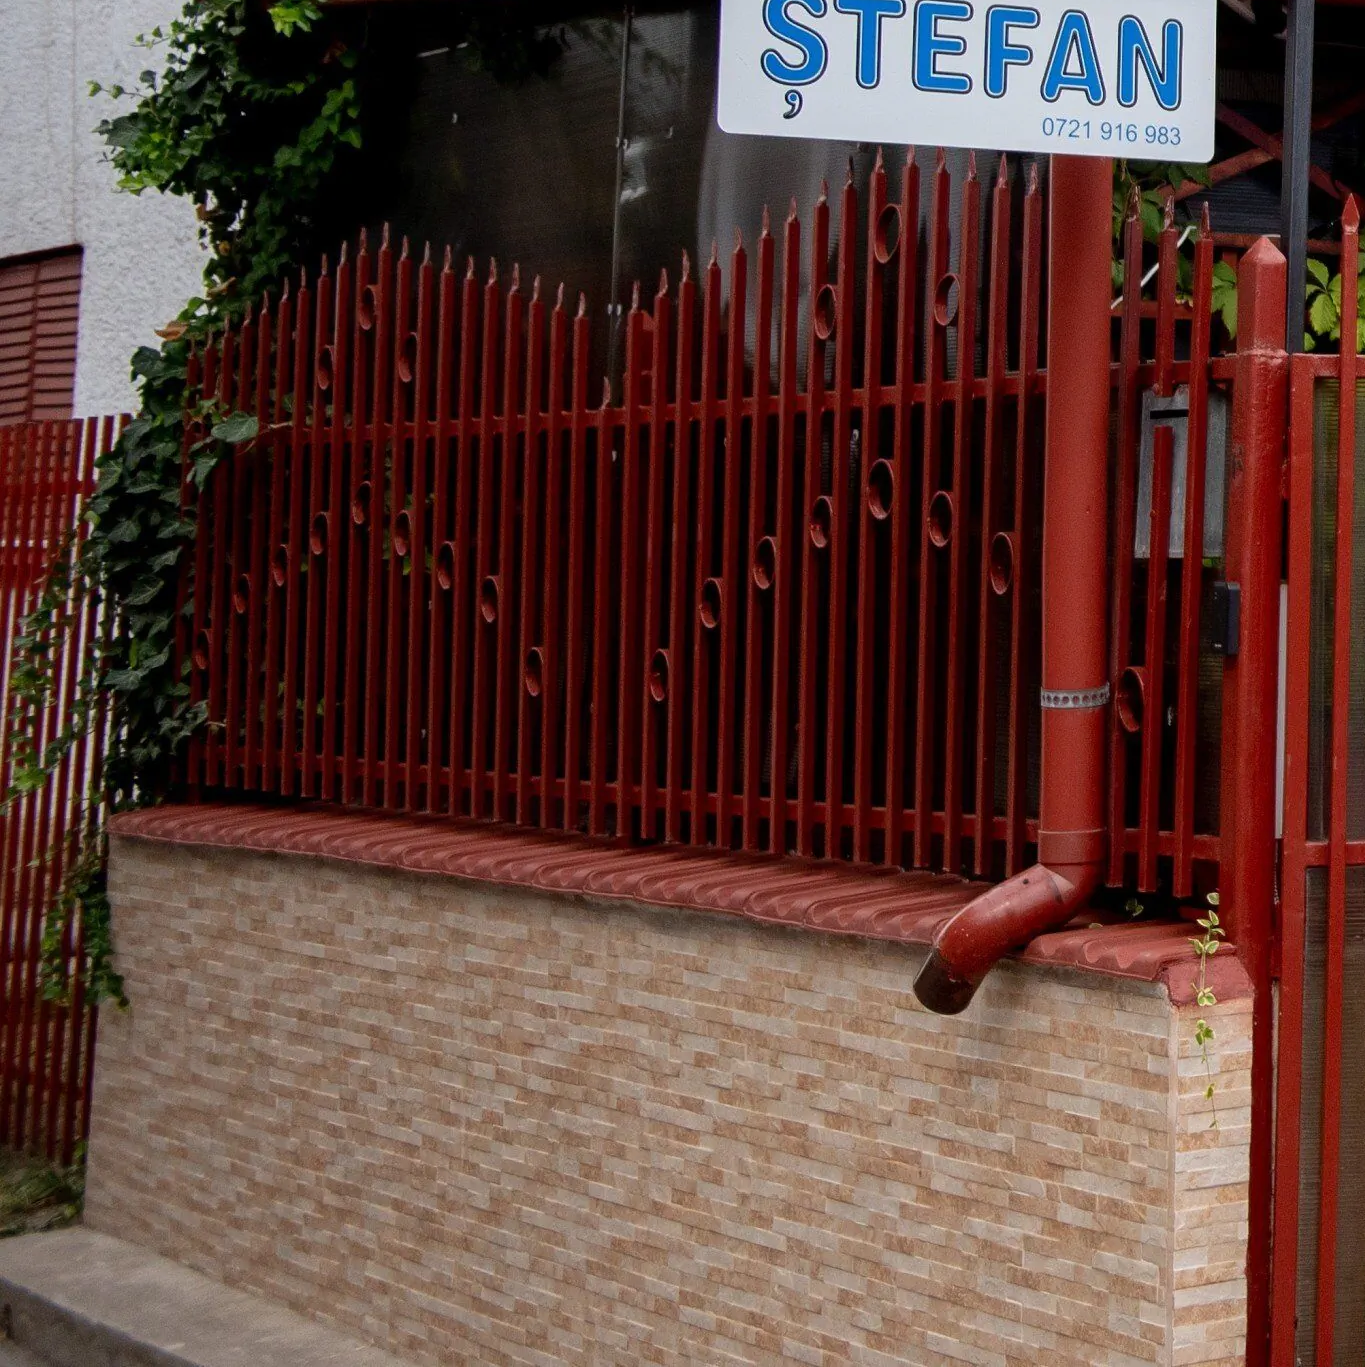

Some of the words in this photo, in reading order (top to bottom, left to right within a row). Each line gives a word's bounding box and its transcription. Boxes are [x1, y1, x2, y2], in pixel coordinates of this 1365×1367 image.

[1042, 117, 1091, 139] 0721
[1100, 121, 1138, 143] 916
[1144, 125, 1181, 146] 983
